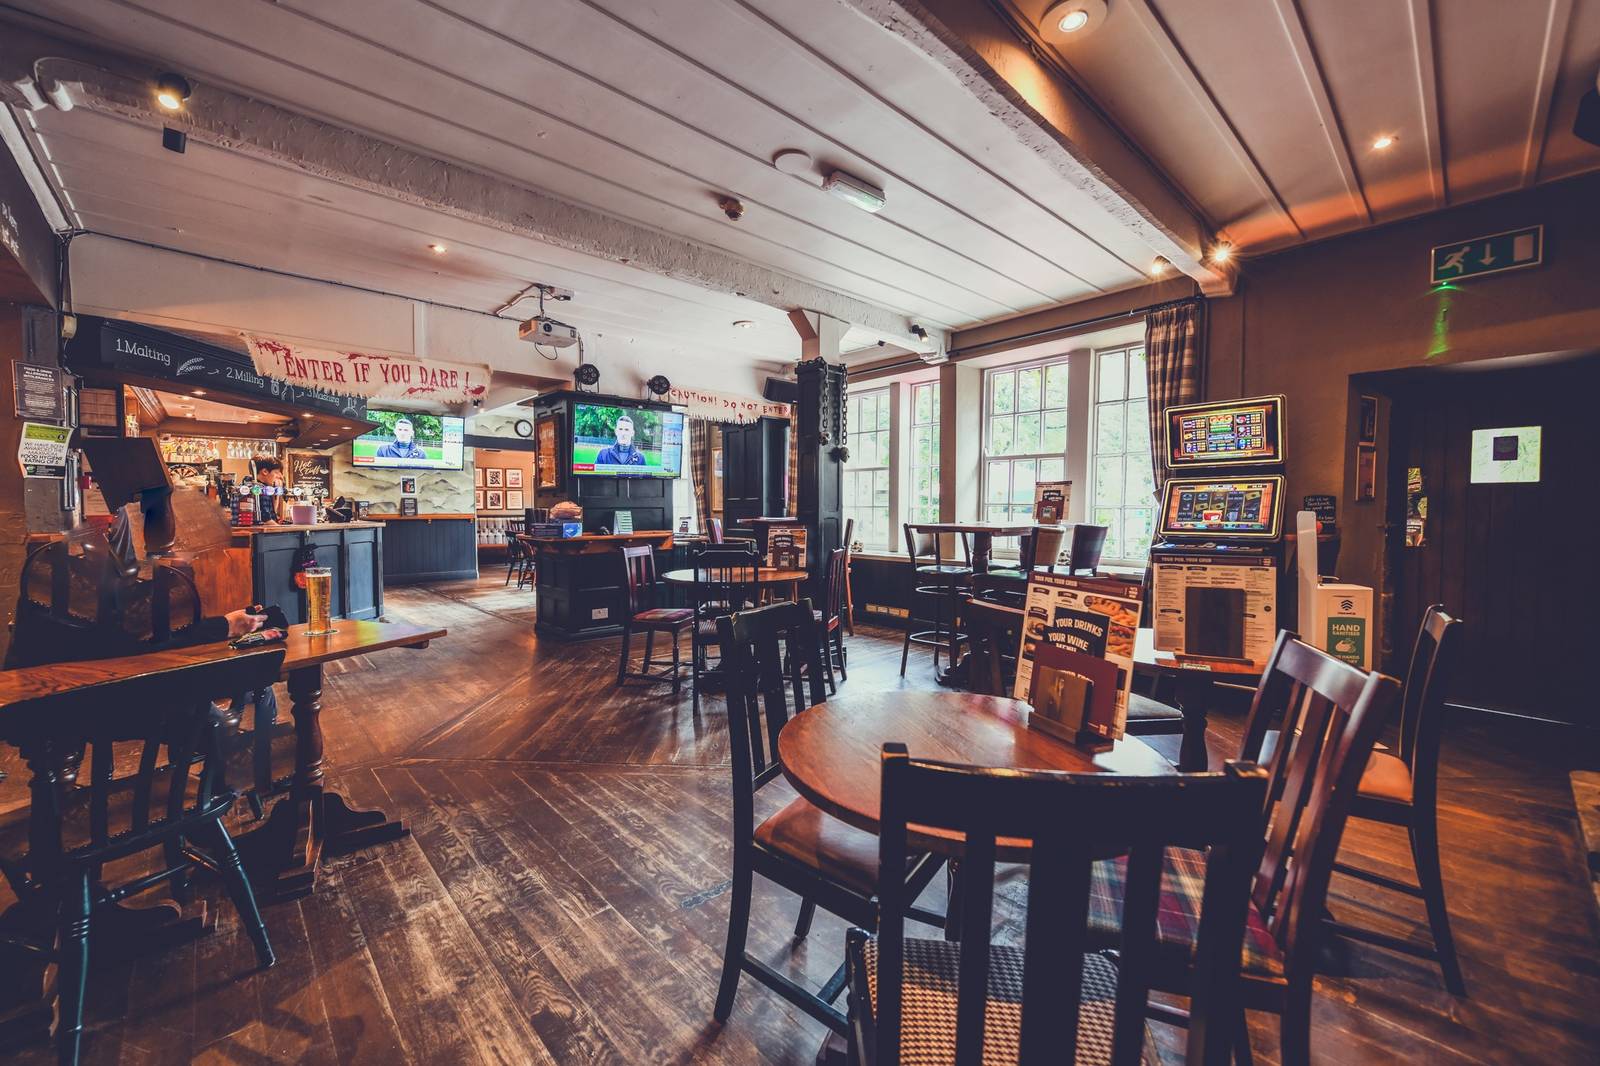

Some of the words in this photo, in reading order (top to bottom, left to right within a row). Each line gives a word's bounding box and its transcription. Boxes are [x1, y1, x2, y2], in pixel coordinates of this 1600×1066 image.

[115, 338, 171, 366] 1.Malting
[226, 366, 265, 388] 2.Milling
[284, 355, 347, 384] ENTER
[353, 362, 370, 383] IF
[380, 363, 411, 385] YOU
[420, 365, 459, 388] DARE
[671, 389, 717, 406] CAUTION!
[723, 399, 737, 409] DO
[741, 401, 759, 410] NOT
[762, 405, 788, 415] ENTER
[1055, 616, 1073, 628] YOUR
[1074, 618, 1104, 637] DRINKS
[1332, 624, 1360, 632] HAND
[1048, 633, 1066, 643] YOUR
[1067, 634, 1089, 652] WINE
